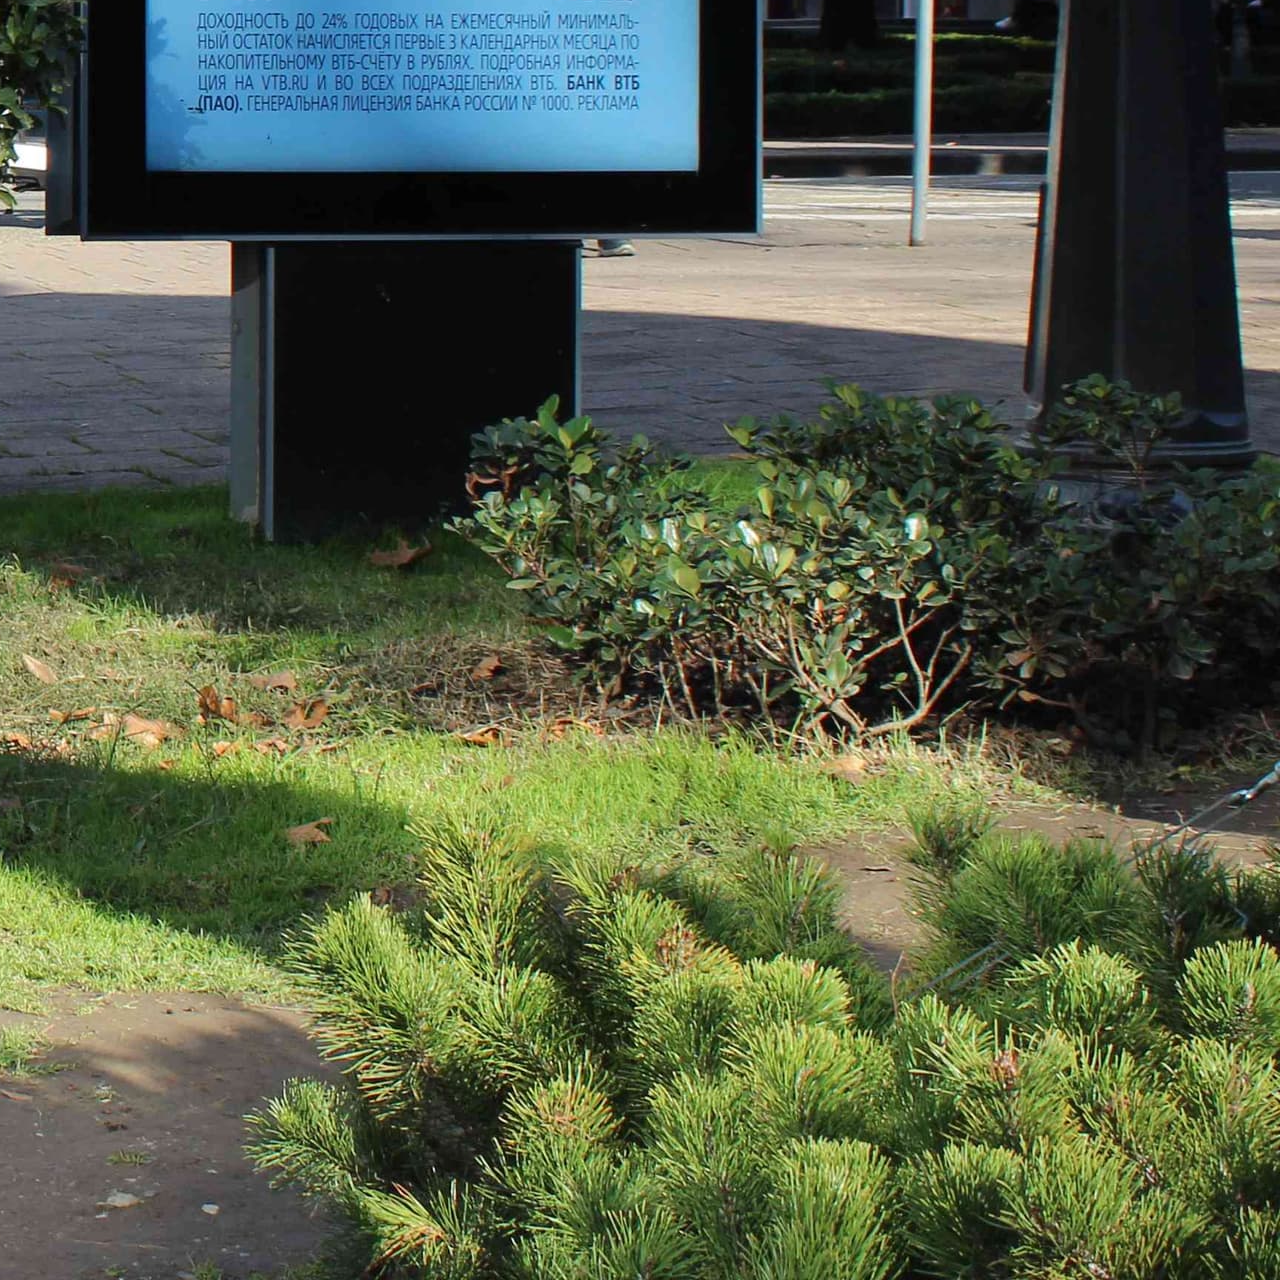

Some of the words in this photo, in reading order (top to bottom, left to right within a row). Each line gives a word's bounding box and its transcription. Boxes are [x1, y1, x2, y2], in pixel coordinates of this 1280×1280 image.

[197, 13, 289, 31] ДОХОДНОСТЬ
[295, 13, 315, 31] ДО
[322, 13, 348, 29] 24%
[355, 13, 419, 30] ГОДОВЫХ
[425, 14, 445, 29] НА
[451, 11, 551, 30] ЕЖЕМЕСЯЧНЫЙ
[558, 14, 639, 30] МИНИМАЛЬ-
[198, 30, 229, 49] НЫЙ
[233, 34, 293, 49] ОСТАТОК
[297, 34, 390, 50] НАЧИСЛЯЕТСЯ
[395, 34, 445, 50] ПЕРВЫЕ
[449, 34, 456, 50] 3
[461, 34, 558, 52] КАЛЕНДАРНЫХ
[564, 34, 617, 52] МЕСЯЦА
[621, 35, 639, 50] ПО
[198, 54, 326, 70] НАКОПИТЕЛЬНОМУ
[332, 51, 401, 70] ВТБ-СЧЁТУ
[407, 55, 415, 70] В
[421, 54, 474, 71] РУБЛЯХ.
[481, 54, 560, 72] ПОДРОБНАЯ
[567, 54, 639, 71] ИНФОРМА-
[198, 75, 226, 92] ЦИЯ
[235, 75, 254, 90] НА
[261, 75, 308, 91] VTB.RU
[317, 75, 327, 90] И
[335, 75, 353, 91] ВО
[362, 75, 394, 90] ВСЕХ
[403, 75, 522, 93] ПОДРАЗДЕЛЕНИЯХ
[531, 75, 557, 91] ВТБ.
[567, 75, 605, 91] БАНК
[615, 75, 640, 91] ВТБ
[198, 94, 242, 113] (ПАО).
[247, 95, 338, 111] ГЕНЕРАЛЬНАЯ
[342, 95, 412, 112] ЛИЦЕНЗИЯ
[416, 95, 461, 111] БАНКА
[465, 95, 518, 111] РОССИИ
[522, 95, 537, 111] №
[541, 95, 573, 111] 1000.
[578, 96, 639, 111] РЕКЛАМА
